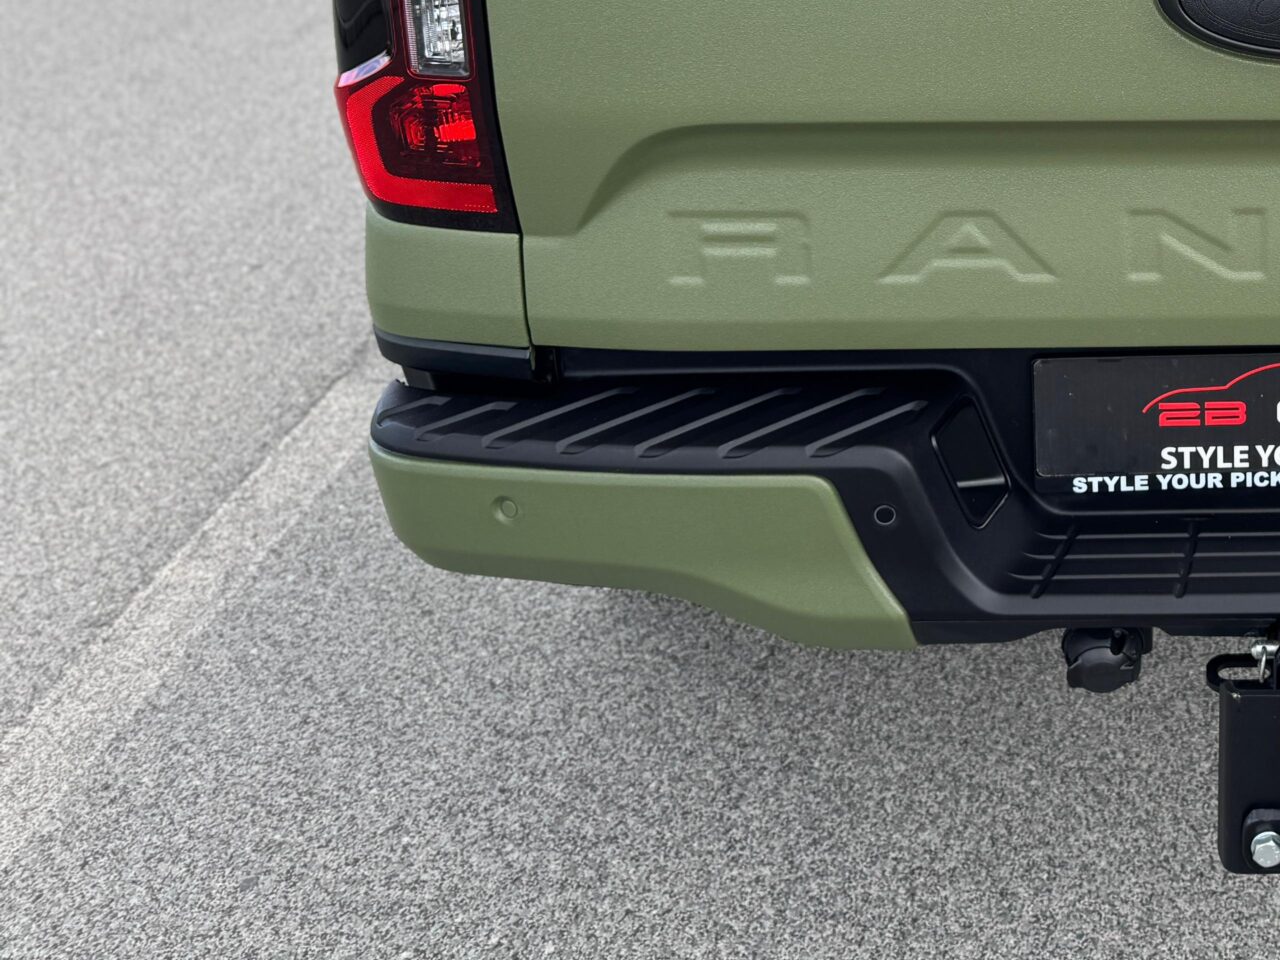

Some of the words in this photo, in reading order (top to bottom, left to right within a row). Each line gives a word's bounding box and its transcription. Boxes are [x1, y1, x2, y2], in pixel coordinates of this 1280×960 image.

[1157, 401, 1247, 427] 2B
[1160, 444, 1249, 470] STYLE
[1072, 475, 1149, 493] STYLE
[1157, 472, 1224, 490] YOUR
